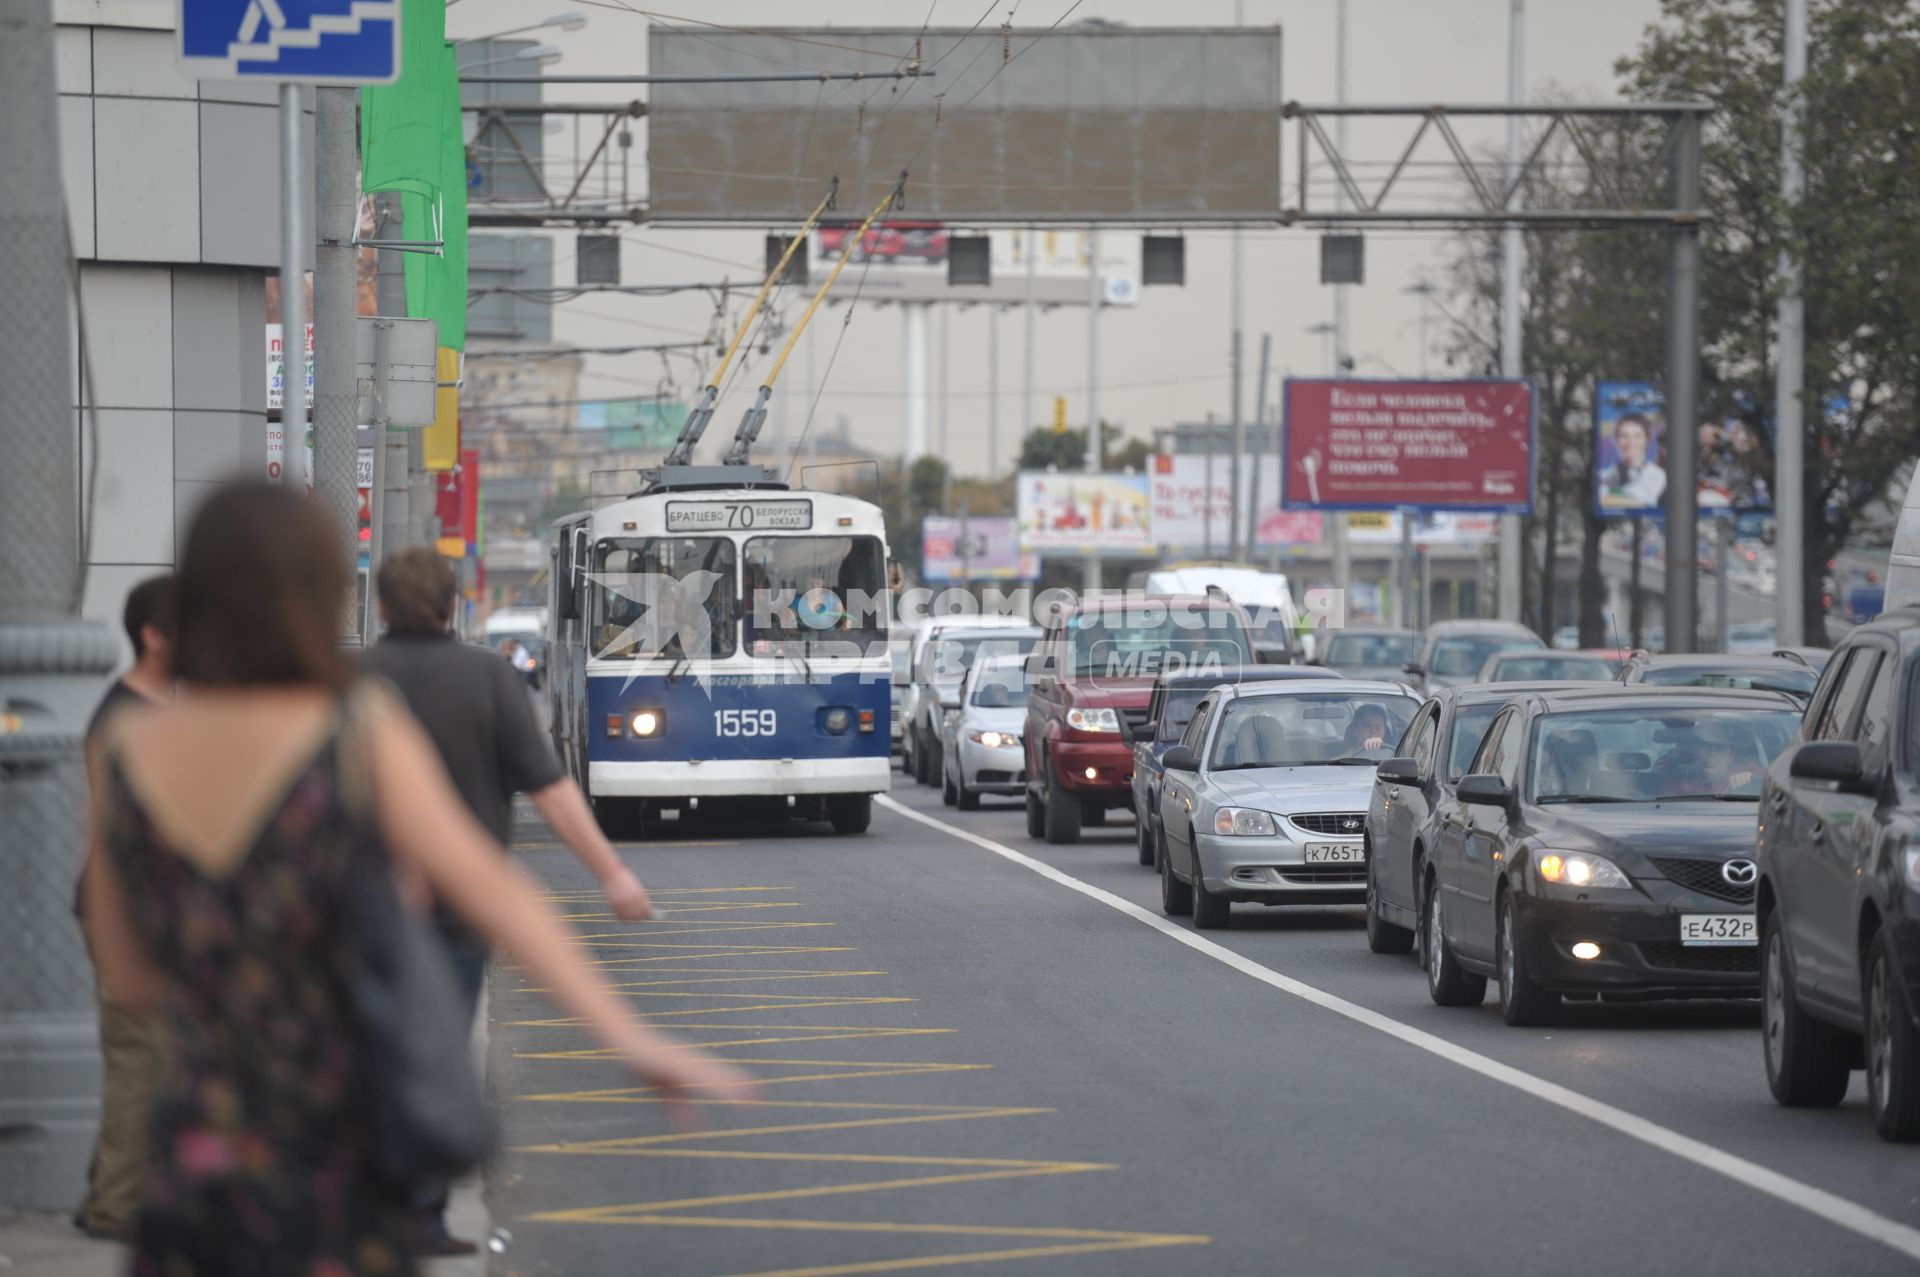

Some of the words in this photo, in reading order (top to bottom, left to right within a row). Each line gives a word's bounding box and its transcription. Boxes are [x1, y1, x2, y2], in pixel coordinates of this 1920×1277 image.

[669, 511, 724, 522] БРАТЦЕВО
[725, 505, 754, 528] 70
[769, 517, 801, 525] ВОКЗАЛ
[714, 709, 776, 736] 1559
